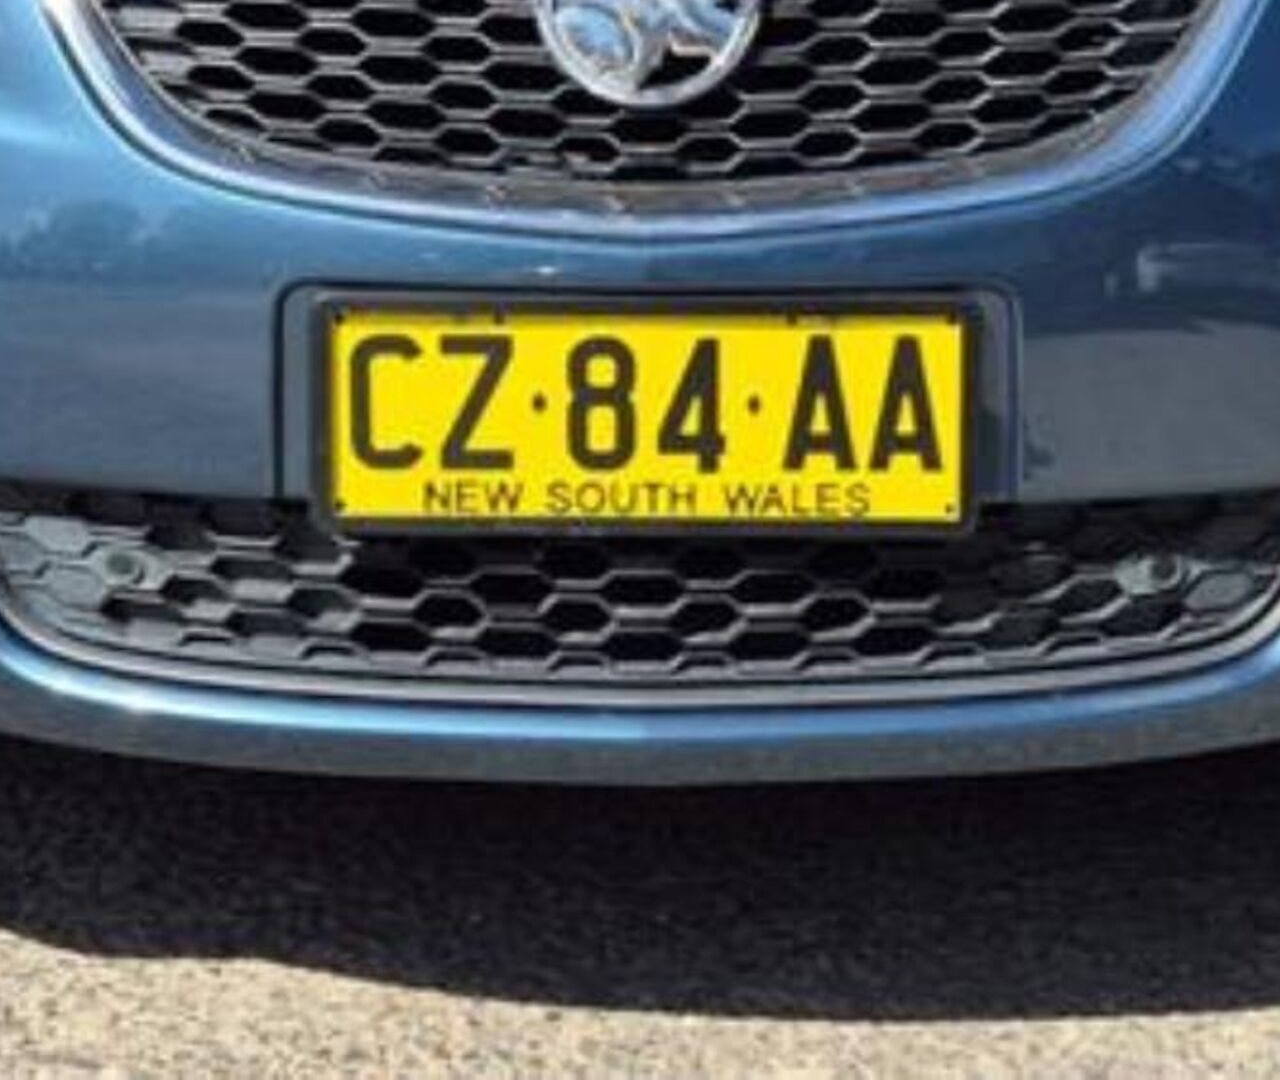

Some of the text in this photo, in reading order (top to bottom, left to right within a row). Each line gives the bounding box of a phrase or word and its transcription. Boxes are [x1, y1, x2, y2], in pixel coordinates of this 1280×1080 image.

[422, 482, 872, 517] NEW SOUTH WALES
